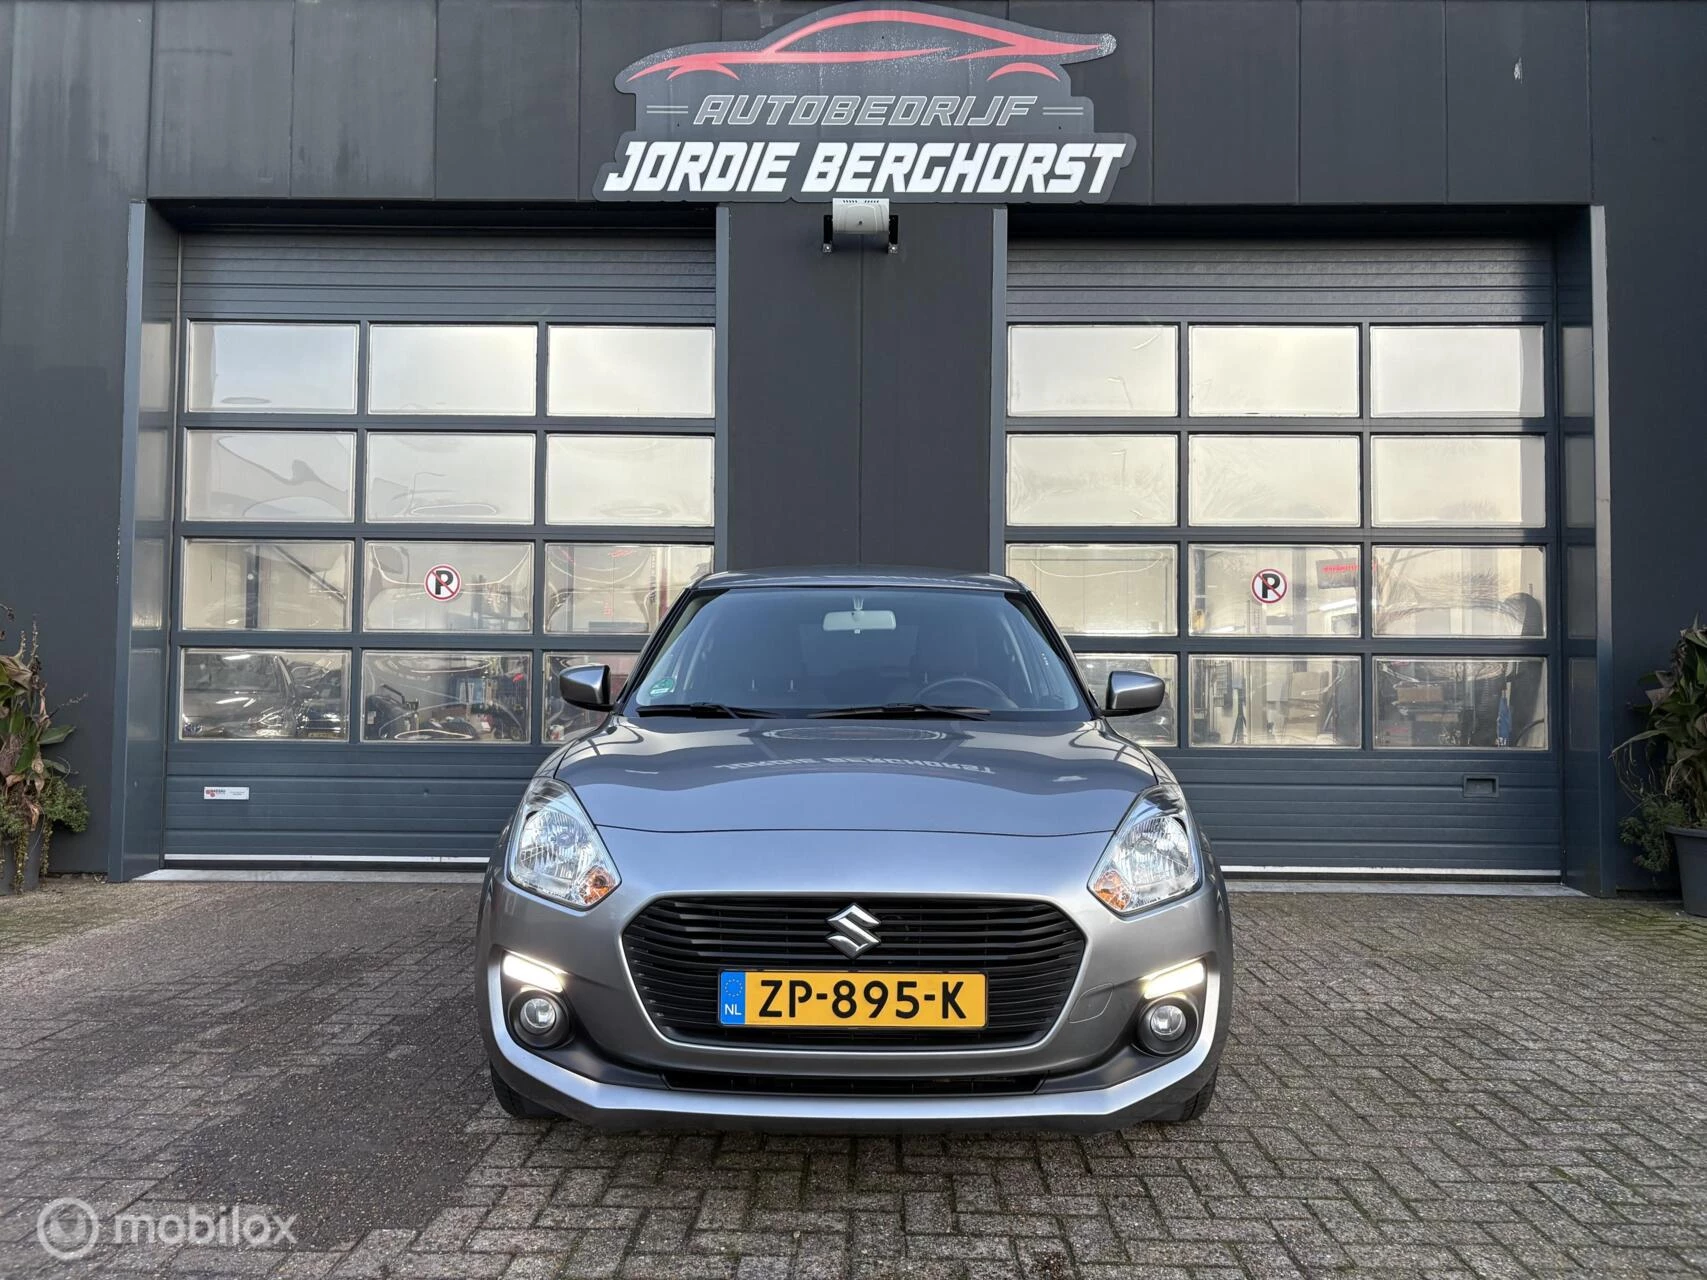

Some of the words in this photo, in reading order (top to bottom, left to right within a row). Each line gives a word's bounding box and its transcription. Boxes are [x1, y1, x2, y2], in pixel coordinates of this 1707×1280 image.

[693, 95, 1037, 126] AUTOBEDRIJF
[603, 141, 800, 192] JORDIE
[801, 143, 1126, 193] BERGHORST
[725, 1004, 741, 1015] NL
[759, 980, 967, 1019] ZP-895-K
